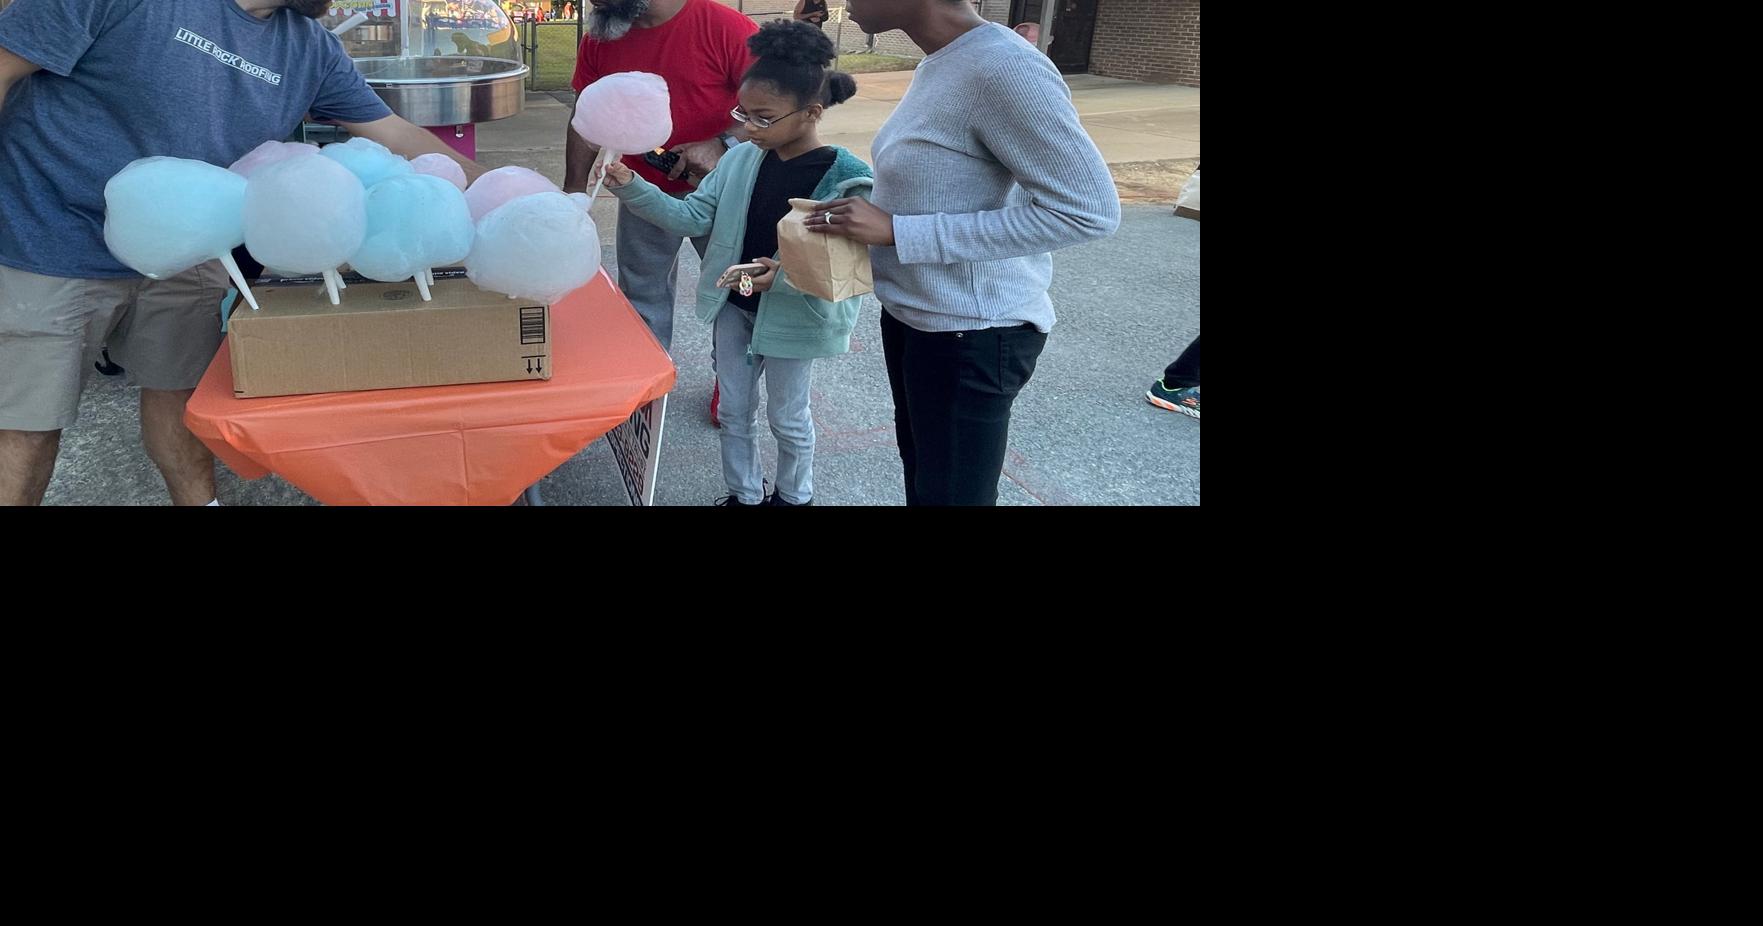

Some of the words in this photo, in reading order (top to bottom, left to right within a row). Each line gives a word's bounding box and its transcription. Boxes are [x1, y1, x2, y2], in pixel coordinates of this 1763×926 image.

[175, 29, 212, 52] LITTLE
[212, 46, 240, 66] ROCK
[240, 60, 281, 84] ROOFING
